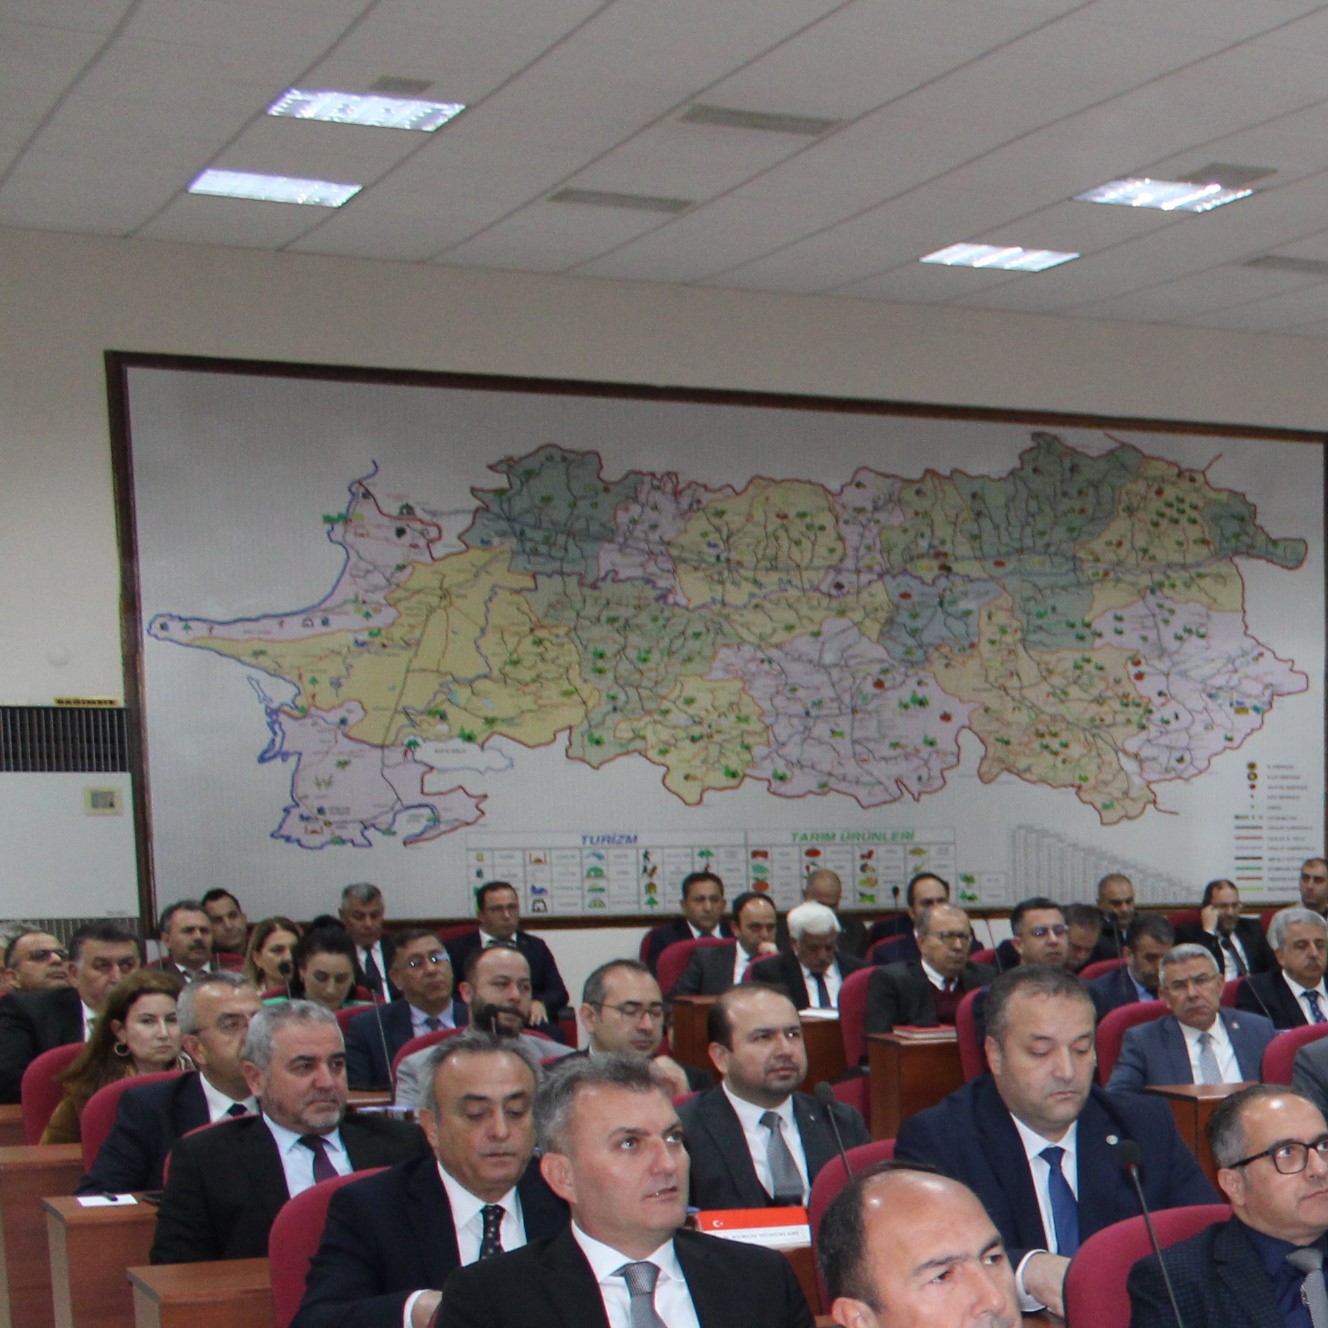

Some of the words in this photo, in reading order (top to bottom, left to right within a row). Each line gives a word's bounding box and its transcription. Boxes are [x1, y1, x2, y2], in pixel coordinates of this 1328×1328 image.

[581, 833, 638, 845] TURİZM
[791, 831, 836, 842] TARIM
[840, 829, 915, 842] ÜRÜNLERİ
